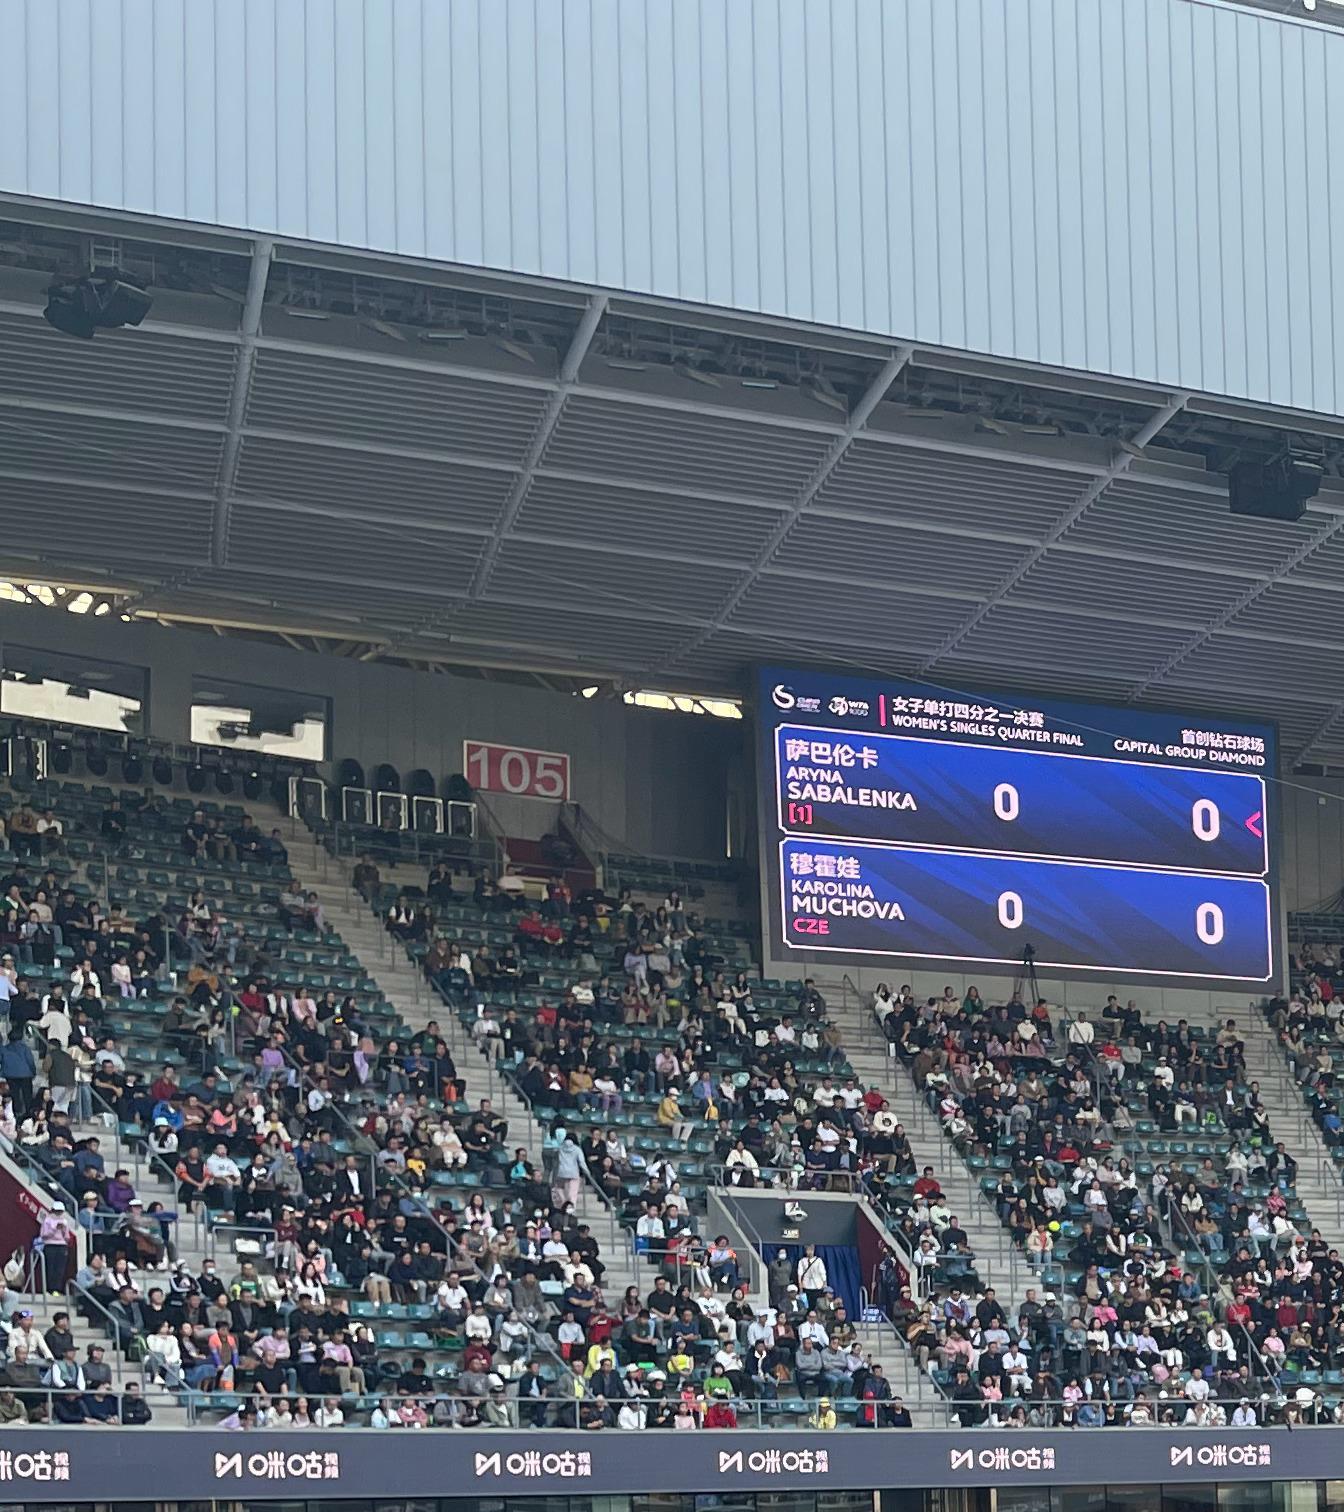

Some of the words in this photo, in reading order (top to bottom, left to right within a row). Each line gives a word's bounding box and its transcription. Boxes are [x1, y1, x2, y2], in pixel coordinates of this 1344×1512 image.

[891, 696, 1045, 732] 女子单打四分之一决赛
[891, 714, 948, 732] WOMEN'S
[949, 720, 996, 737] SINGLES
[997, 726, 1051, 743] QUARTER
[1052, 732, 1085, 747] FINAL
[1181, 729, 1265, 753] 首创钻石球场
[784, 738, 879, 770] 萨巴伦卡
[1113, 739, 1163, 756] CAPITAL
[1164, 744, 1207, 760] GROUP
[1209, 749, 1266, 767] DIAMOND
[469, 745, 564, 801] 105
[787, 769, 843, 784] ARYNA
[787, 781, 918, 816] SABALENKA
[993, 782, 1019, 821] 0
[1192, 798, 1220, 842] 0
[789, 852, 861, 880] 穆霍娃
[791, 877, 875, 899] KAROLINA
[792, 894, 905, 921] MUCHOVA
[997, 890, 1024, 929] 0
[1196, 901, 1224, 945] 0
[793, 918, 829, 935] CZE
[0, 1450, 70, 1481] 咕视频
